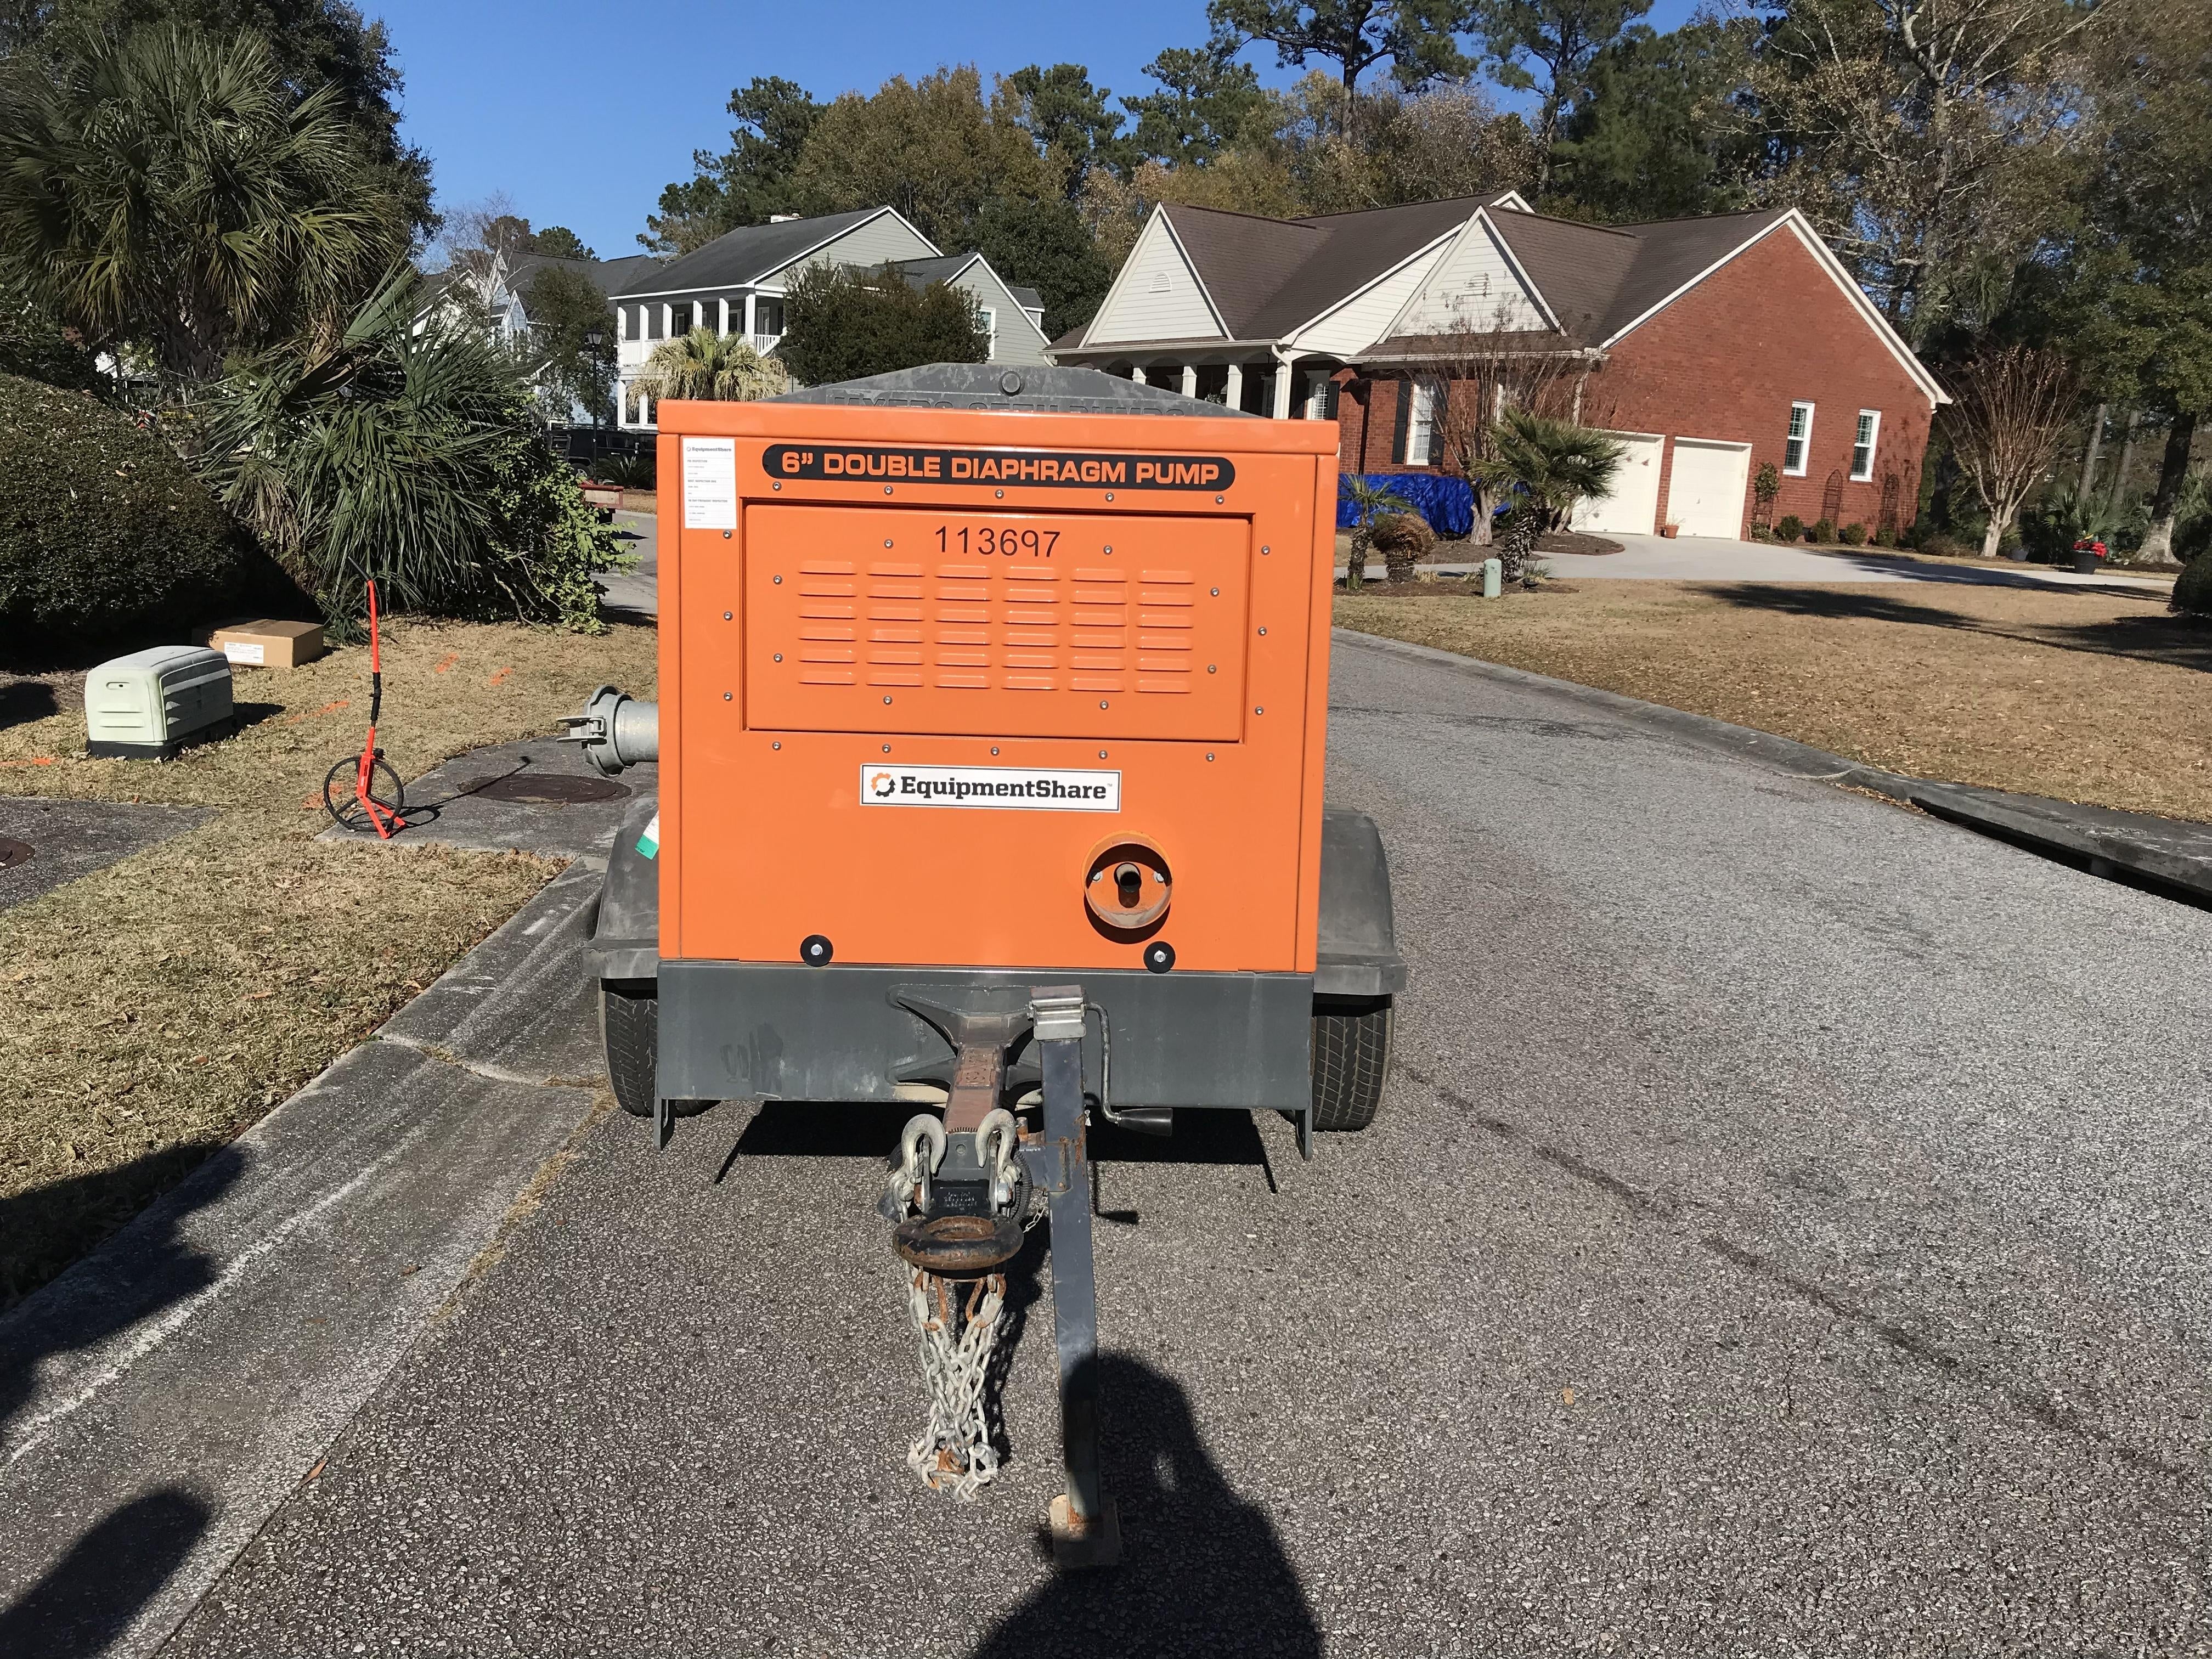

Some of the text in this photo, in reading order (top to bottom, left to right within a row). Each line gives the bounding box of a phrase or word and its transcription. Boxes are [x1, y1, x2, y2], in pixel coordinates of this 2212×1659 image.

[824, 453, 941, 477] DOUBLE
[951, 458, 1126, 483] DIAPHRAGM
[1136, 462, 1219, 484] PUMP
[935, 526, 1060, 557] 113697
[900, 776, 1106, 800] EquipmentShare
